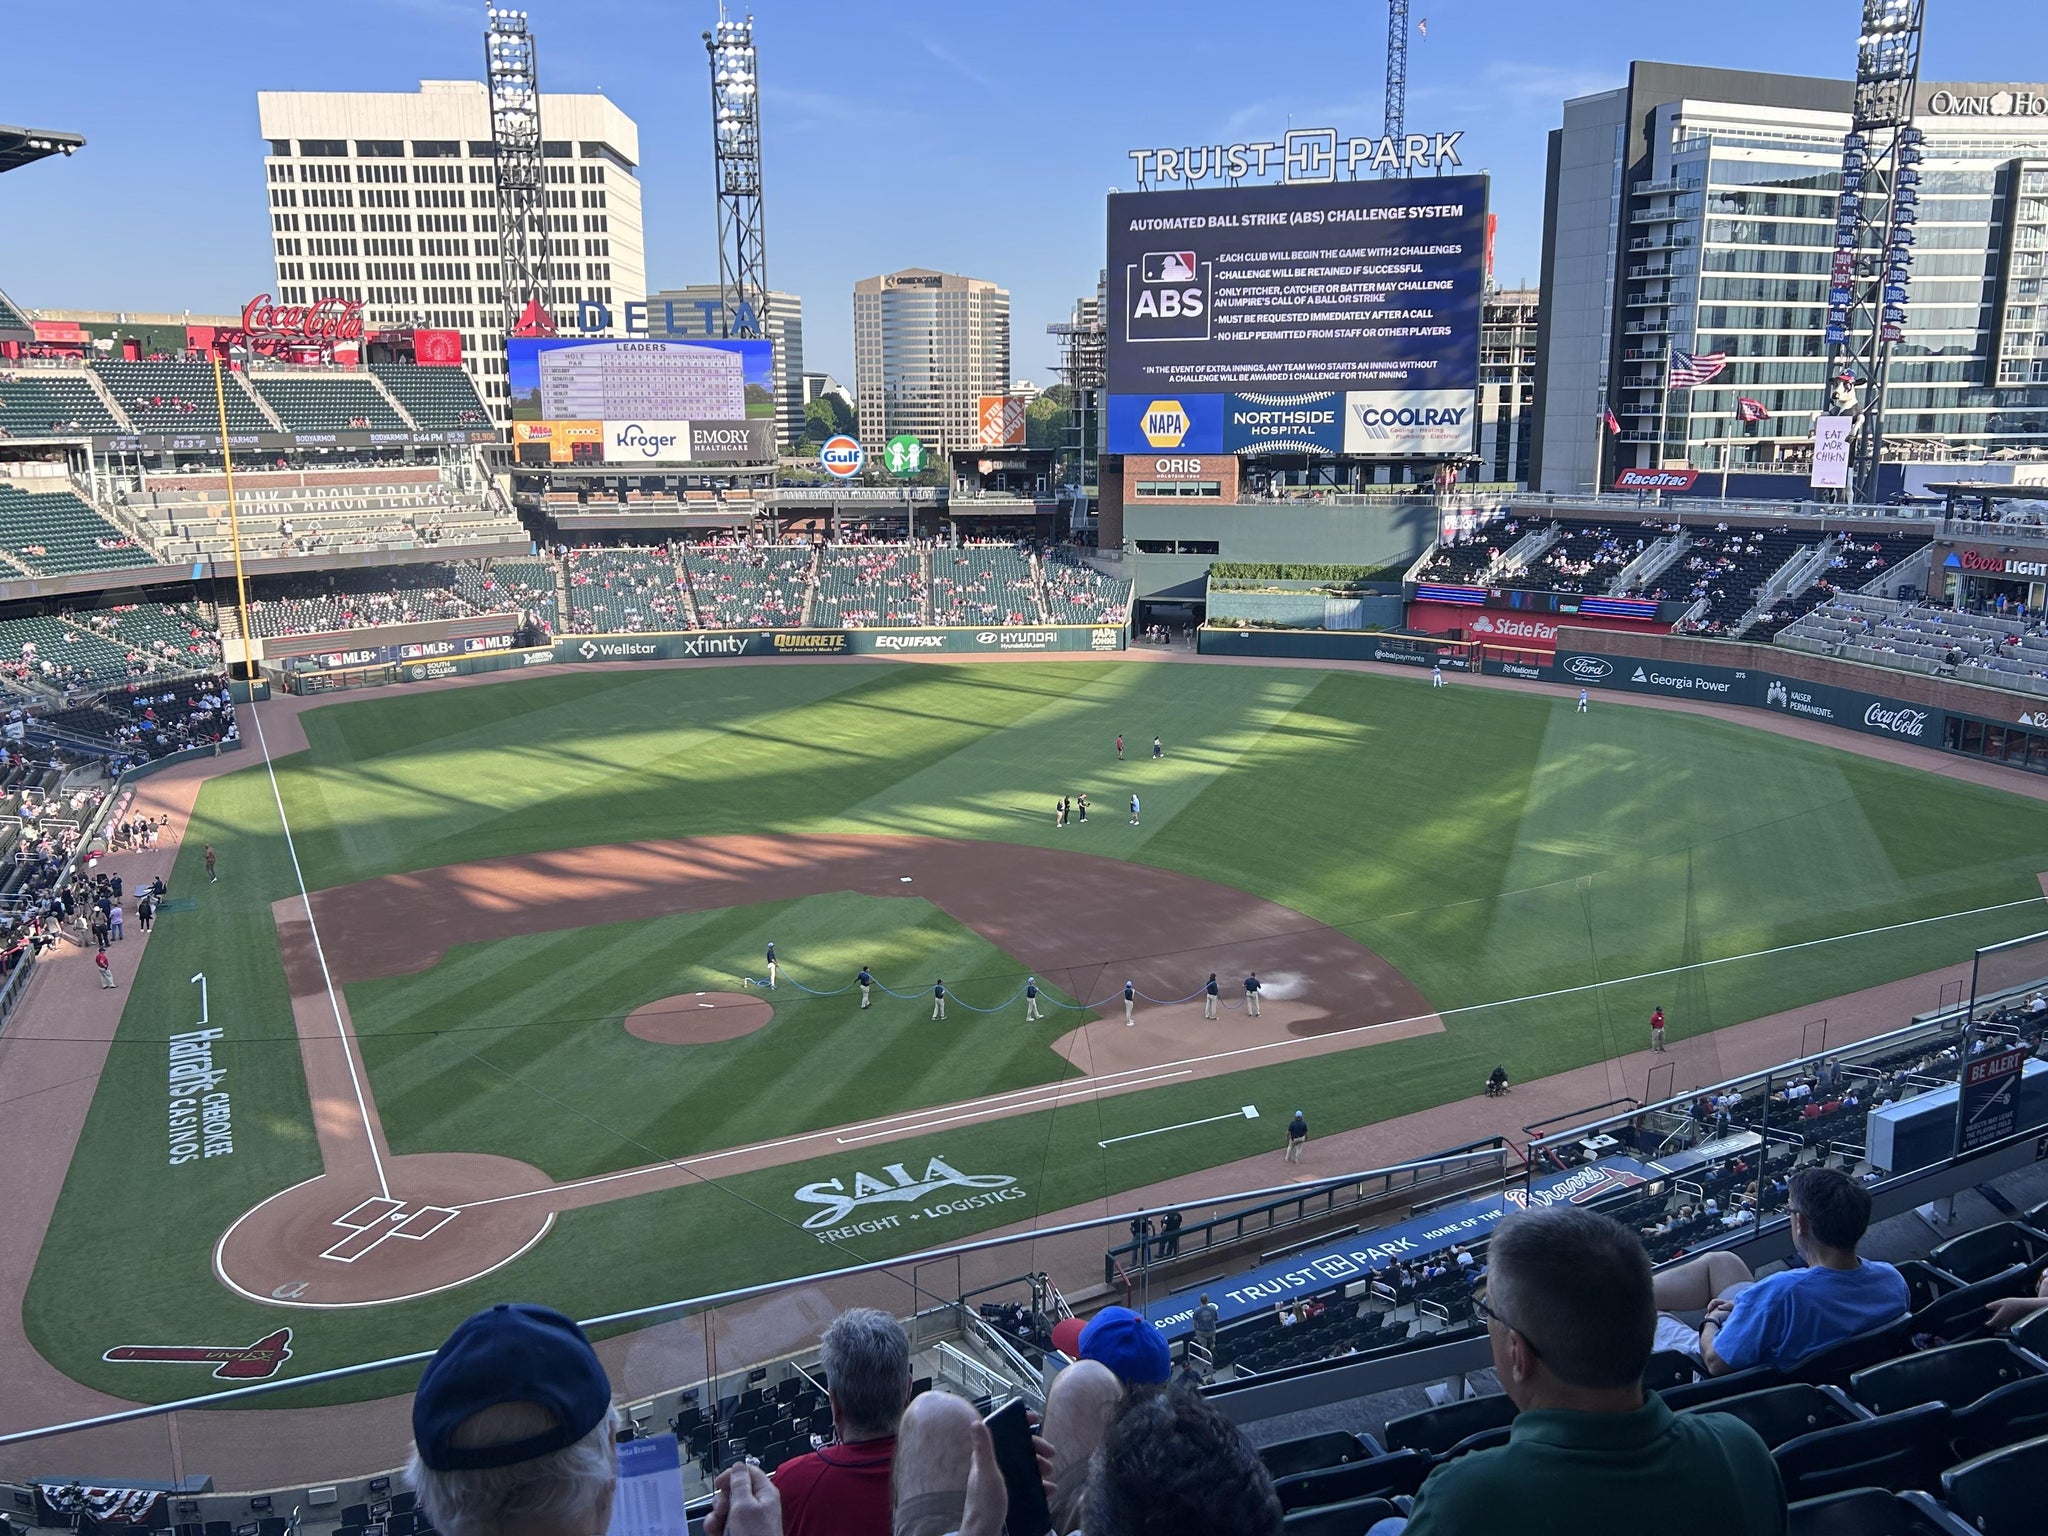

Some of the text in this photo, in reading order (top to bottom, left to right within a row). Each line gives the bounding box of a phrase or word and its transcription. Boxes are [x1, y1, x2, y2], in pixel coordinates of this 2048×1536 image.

[1930, 90, 1990, 114] OMNI
[1847, 136, 1863, 147] 1872
[1904, 130, 1920, 141] 1873
[1129, 131, 1465, 183] TRUIST PARK
[1845, 156, 1861, 167] 1874
[1902, 150, 1918, 161] 1875
[1843, 176, 1859, 187] 1877
[1900, 171, 1916, 181] 1878
[1897, 191, 1914, 202] 1891
[1129, 204, 1463, 231] AUTOMATED BALL STRIKE (ABS) CHALLENGE SYSTEM
[1840, 215, 1856, 226] 1892
[1896, 211, 1913, 221] 1893
[1838, 235, 1854, 245] 1897
[1219, 244, 1462, 262] EACH CLUB WILL BEGIN THE GAME WITH CHALLENGES
[1892, 250, 1909, 261] 1948
[1219, 264, 1423, 280] CHALLENGE WILL BE RETAINED IF SUCCESSFUL
[1834, 273, 1850, 283] 1957
[1890, 270, 1906, 280] 1958
[1219, 280, 1454, 297] ONLY PITCHER, CATCHER OR BATTER MAY CHALLENGE
[1888, 290, 1905, 300] 1982
[1134, 288, 1204, 319] ABS
[1229, 293, 1386, 307] UMPIRE'S CALL OF BALL OR STRIKE
[242, 293, 370, 339] Coca-Cola
[578, 300, 761, 335] DELTA
[1218, 309, 1434, 324] MUST BE REQUESTED IMMEDIATELY AFTER CALL
[1830, 311, 1846, 322] 1991
[1885, 309, 1902, 319] 1992
[1218, 326, 1452, 341] NO HELP PERMITTED FROM STAFF OR OTHER PLAYERS
[1828, 330, 1844, 340] 1993
[1883, 328, 1900, 338] 1995
[616, 343, 667, 352] LEADERS
[1156, 360, 1438, 374] THE EVENT EXTRA INNINGS, ANY TEAM WHO STARTS INNING WITHOUT
[1176, 374, 1219, 382] CHALLENGE
[1220, 374, 1238, 382] WILL
[1250, 373, 1287, 381] AWARDED
[1294, 372, 1340, 380] CHALLENGE
[1341, 372, 1356, 380] FOR
[1379, 371, 1407, 379] INNING
[980, 396, 1025, 444] HOME
[1149, 414, 1182, 434] NAPA
[1234, 411, 1335, 424] NORTHSIDE
[1362, 408, 1468, 426] COOLRAY
[693, 429, 750, 444] EMORY
[997, 415, 1025, 444] DEPOT
[1252, 426, 1316, 435] HOSPITAL
[1824, 430, 1844, 440] EAT
[173, 440, 194, 448] 81.3
[413, 434, 429, 442] 6:44
[430, 433, 444, 442] PM
[617, 424, 677, 457] Kroger
[110, 441, 126, 449] 9.5
[1823, 441, 1843, 450] MOR
[824, 450, 860, 463] Gulf
[1816, 452, 1846, 462] CHIKIN
[1155, 458, 1201, 473] ORIS
[1622, 472, 1688, 486] RaceTrac
[291, 487, 367, 512] AARON
[1962, 550, 2048, 576] Coors LIGHT
[773, 633, 845, 647] QUIKRETE
[1000, 632, 1057, 643] HYUNDAI
[1092, 628, 1117, 638] PAPA
[684, 634, 749, 656] xfinity
[875, 635, 946, 650] EQUIFAX
[1091, 637, 1117, 645] JOHNS
[422, 641, 455, 656] MLB+
[600, 642, 656, 656] Wellstar
[342, 651, 377, 665] MLB+
[427, 661, 450, 669] SOUTH
[427, 666, 457, 674] COLLEGE
[1510, 666, 1540, 676] National
[1571, 657, 1604, 676] Ford
[1650, 672, 1730, 693] Georgia Power
[1735, 672, 1746, 680] 375
[1790, 691, 1812, 703] KAISER
[1790, 702, 1834, 718] PERMANENTE
[1864, 702, 1929, 736] Coca-Cola
[169, 1027, 228, 1097] Harrah's
[1972, 1052, 2020, 1080] BE ALERT
[169, 1098, 200, 1165] CASINOS
[201, 1092, 234, 1159] CHEROKEE
[794, 1157, 1018, 1229] SAIA
[1504, 1166, 1604, 1212] Braves
[816, 1186, 1027, 1244] FREIGHT LOGISTICS
[1422, 1209, 1506, 1241] HOME OF THE
[1225, 1236, 1419, 1304] TRUIST PARK
